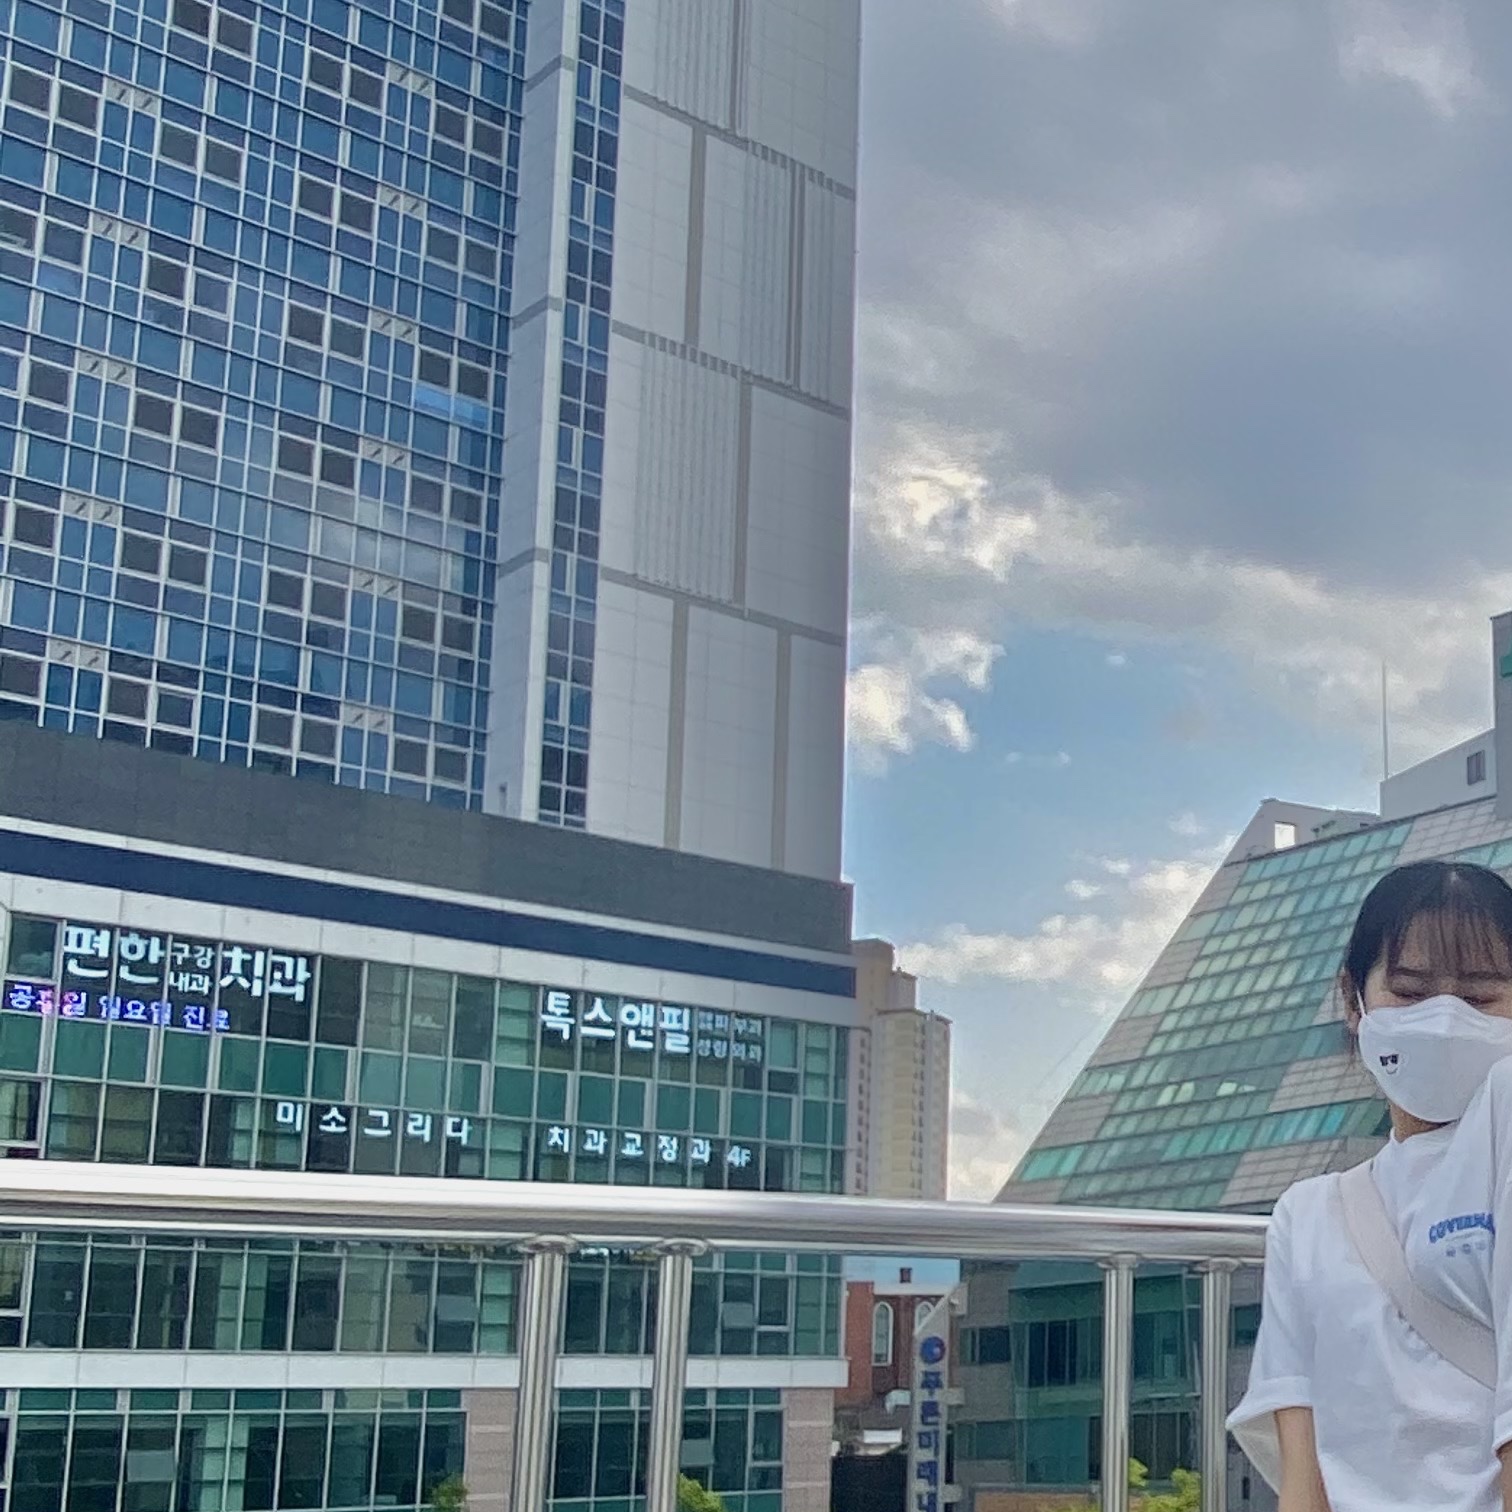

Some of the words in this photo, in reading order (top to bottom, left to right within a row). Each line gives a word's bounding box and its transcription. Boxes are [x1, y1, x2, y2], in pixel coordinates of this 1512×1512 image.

[64, 925, 166, 985] 편한
[169, 970, 213, 996] 내과
[170, 942, 215, 968] 구강
[220, 946, 311, 1002] 치과
[541, 991, 692, 1055] 톡스앤필
[276, 1101, 472, 1146] 미소그리다
[547, 1124, 714, 1167] 치과교정과
